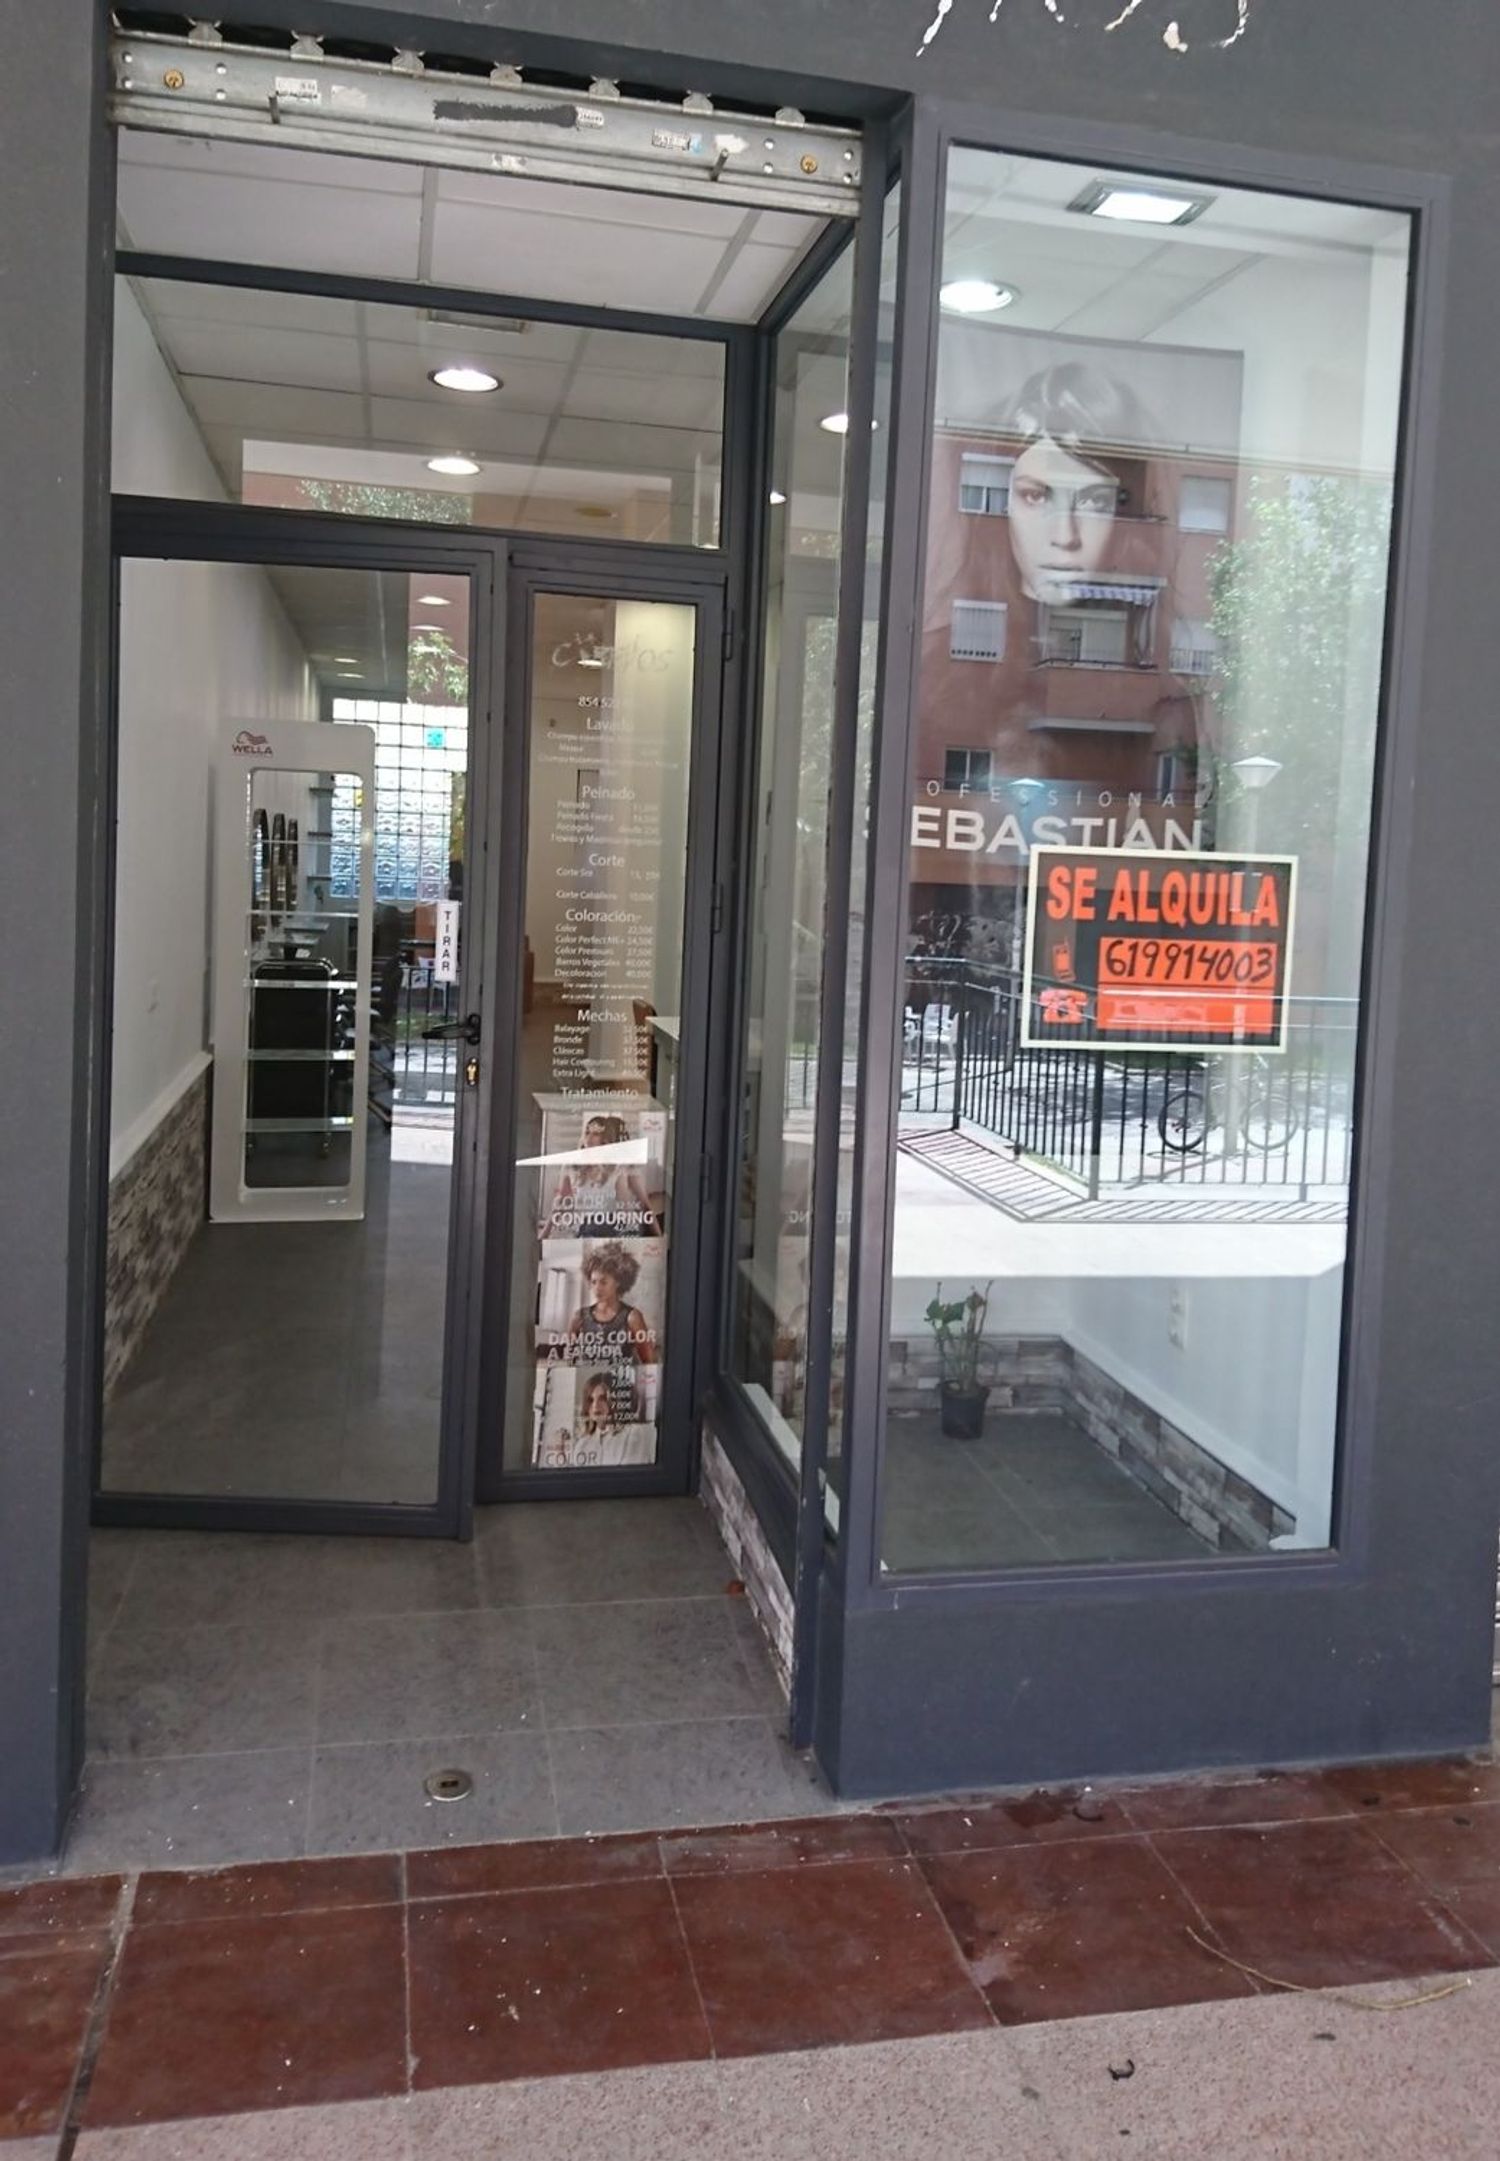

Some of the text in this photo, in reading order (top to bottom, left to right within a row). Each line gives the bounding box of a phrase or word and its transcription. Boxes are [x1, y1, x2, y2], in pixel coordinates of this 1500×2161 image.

[231, 744, 273, 755] WELLA
[582, 786, 636, 800] Peinado
[589, 853, 626, 867] Corte
[1047, 866, 1279, 927] SE ALQUILA
[442, 911, 452, 972] TIRAR
[1105, 940, 1273, 984] 619914003
[577, 1009, 628, 1023] Mechas
[561, 1087, 640, 1100] Tratamiento
[552, 1211, 655, 1226] CONTOURING
[548, 1329, 657, 1346] DAMOS COLOR
[546, 1451, 598, 1467] COLOR
